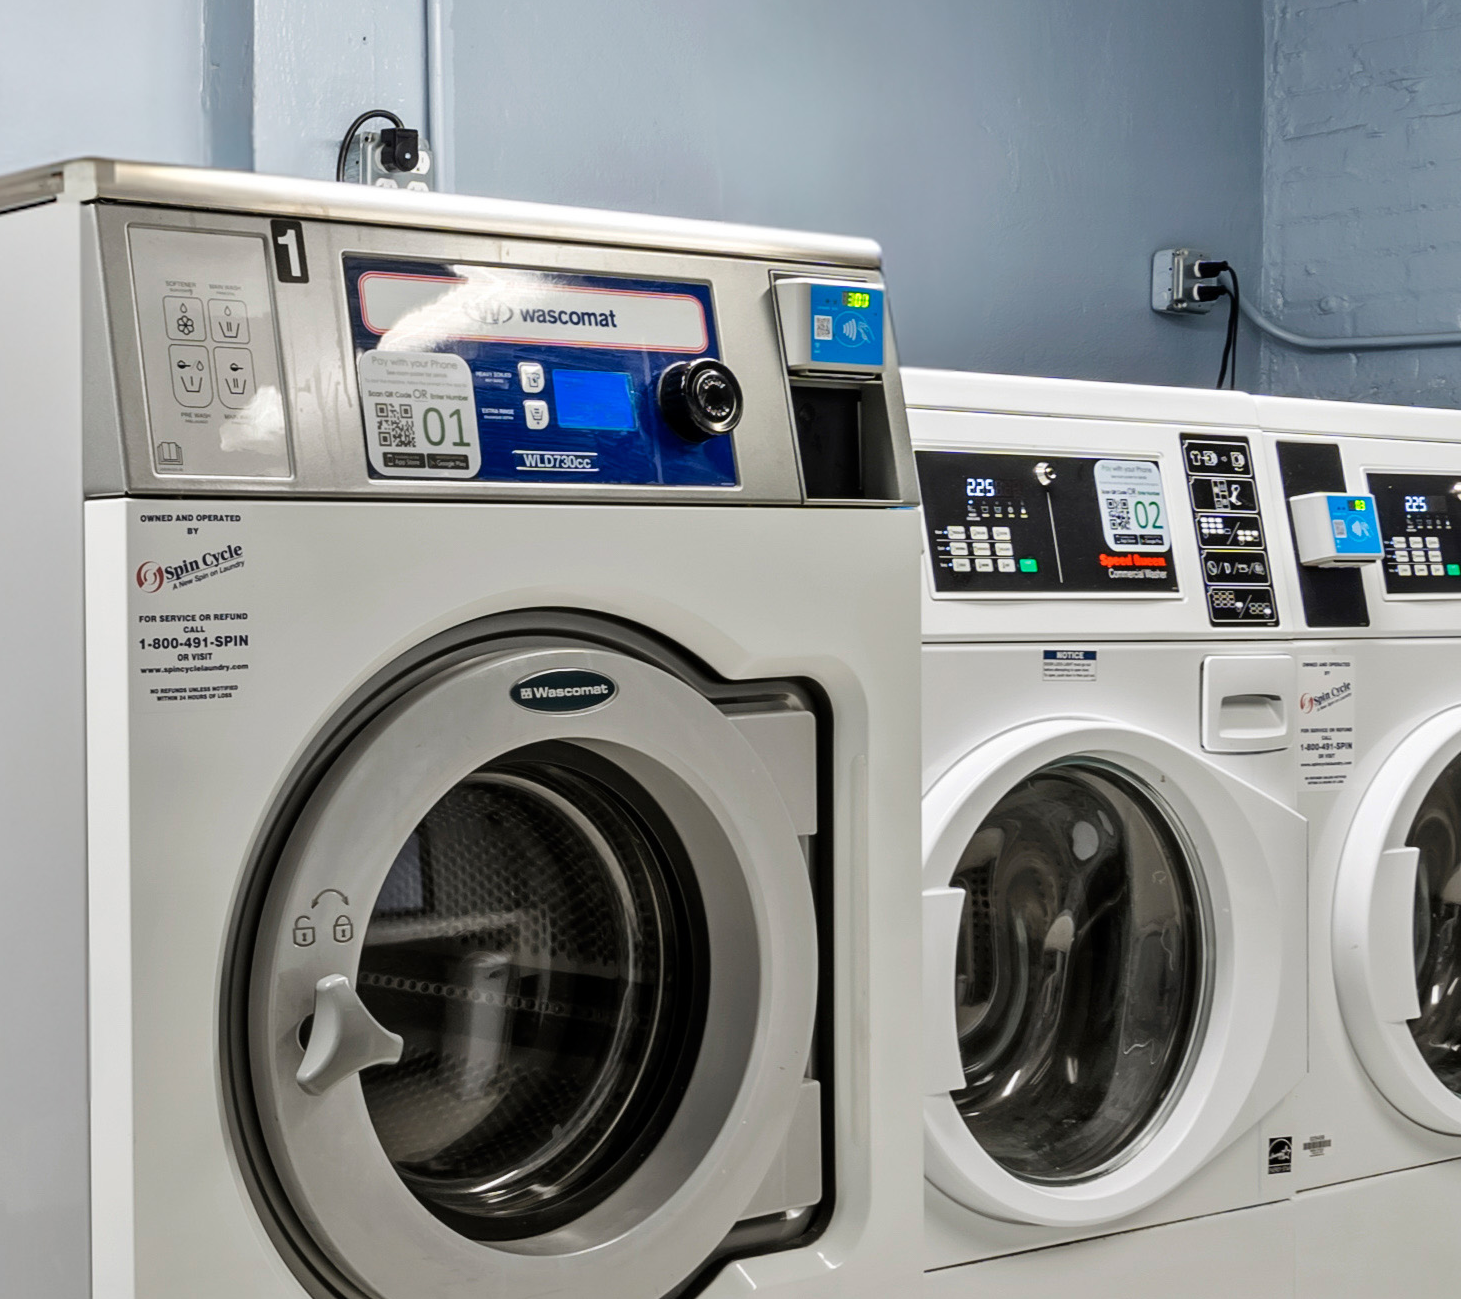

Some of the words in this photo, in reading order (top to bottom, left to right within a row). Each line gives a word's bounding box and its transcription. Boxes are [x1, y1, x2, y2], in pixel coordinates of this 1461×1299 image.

[277, 229, 302, 278] 1
[520, 308, 617, 328] wascomat
[371, 356, 388, 367] Pay
[391, 358, 410, 368] with
[410, 360, 429, 371] your
[431, 360, 459, 370] Phone
[368, 390, 384, 398] Scan
[395, 391, 412, 399] Code
[413, 389, 428, 400] OR
[423, 407, 471, 447] 01
[523, 454, 591, 468] WLD730cc
[966, 478, 995, 497] 225
[1405, 496, 1427, 512] 225
[175, 514, 194, 522] AND
[1134, 500, 1164, 529] 02
[187, 527, 199, 535] BY
[164, 560, 200, 580] Spin
[202, 544, 243, 567] Cycle
[1099, 553, 1133, 568] Speed
[1133, 554, 1167, 567] Queen
[179, 578, 193, 588] New
[194, 573, 209, 583] Spin
[219, 560, 245, 574] Laundry
[139, 615, 157, 623] FOR
[159, 614, 197, 622] SERVICE
[213, 612, 248, 621] REFUND
[139, 634, 249, 650] 1-800-491-SPIN
[177, 653, 189, 662] OR
[191, 652, 213, 661] VISIT
[1056, 651, 1085, 659] NOTICE
[140, 663, 249, 674] www.spincyclelaundry.com
[533, 683, 608, 699] Wascomat
[1313, 691, 1331, 705] Spin
[1331, 682, 1351, 697] Cycle
[1300, 742, 1353, 751] 1-800-491-SPIN
